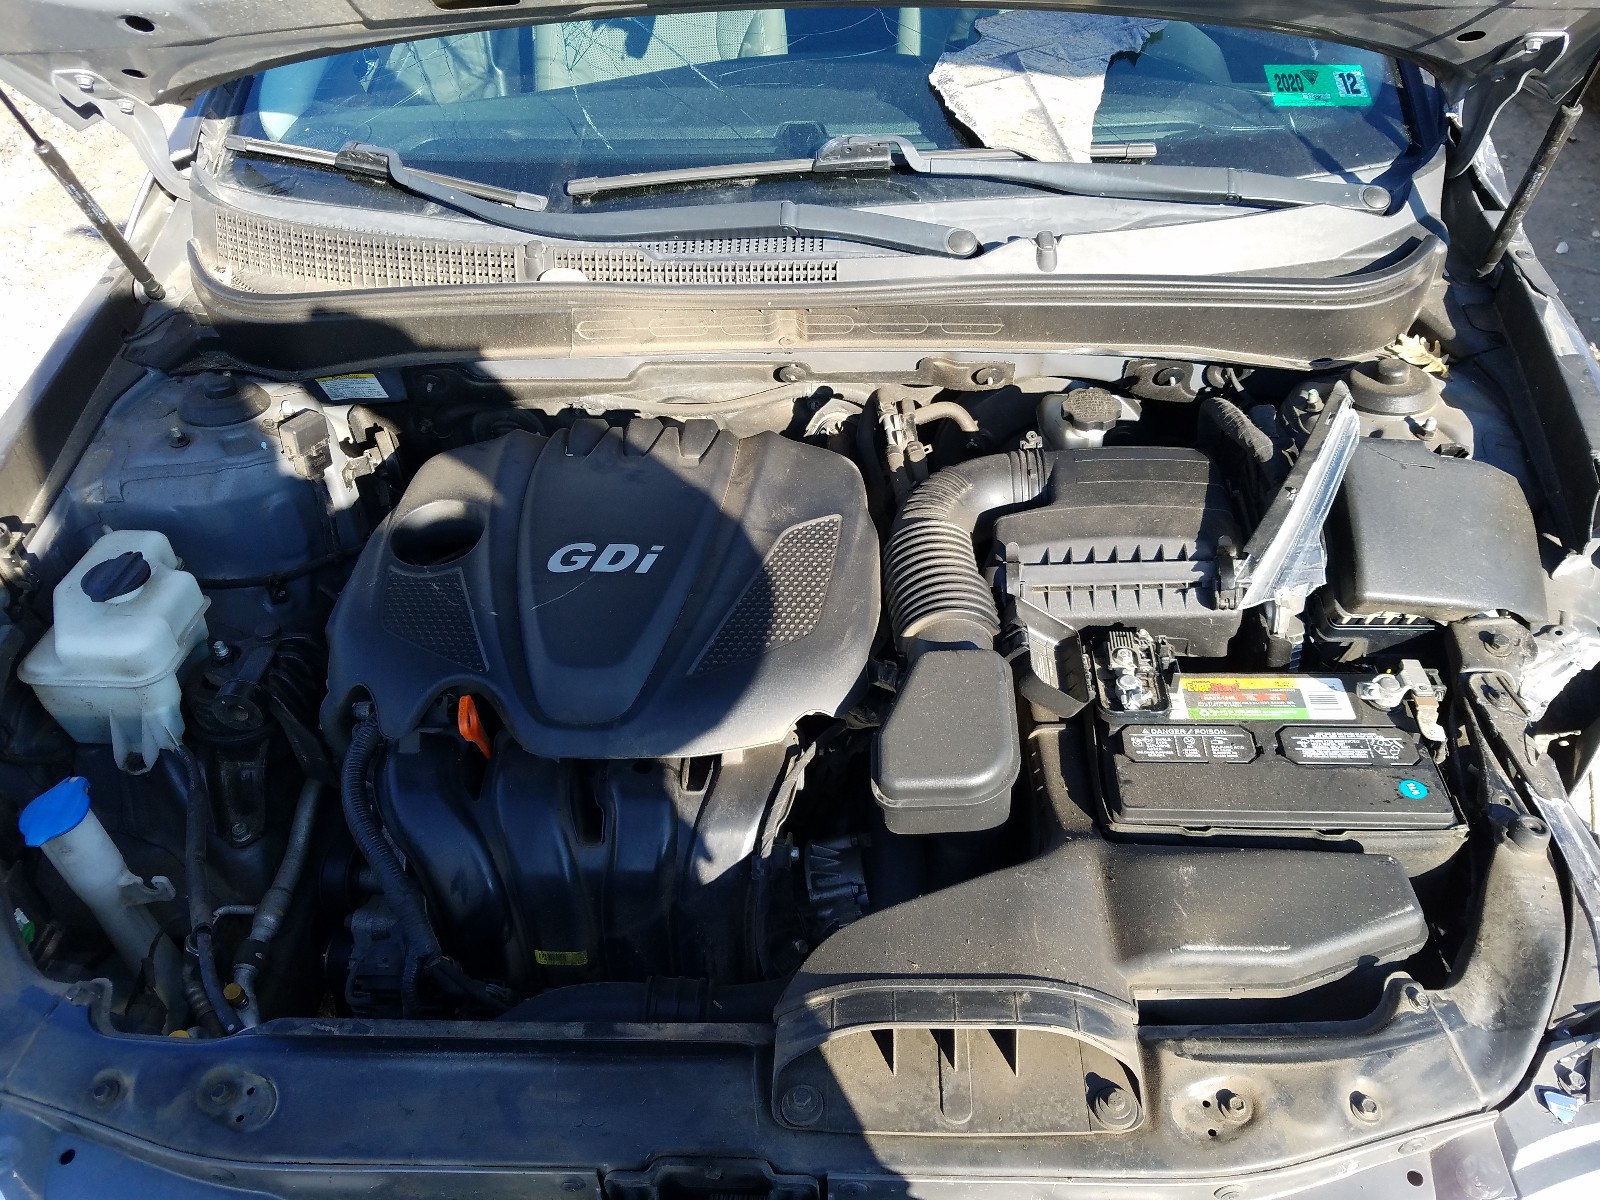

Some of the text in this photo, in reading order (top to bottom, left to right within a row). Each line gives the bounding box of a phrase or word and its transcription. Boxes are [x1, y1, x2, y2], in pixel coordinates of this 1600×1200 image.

[1274, 73, 1304, 92] 2020
[1338, 73, 1362, 94] 12
[547, 542, 665, 574] GDi
